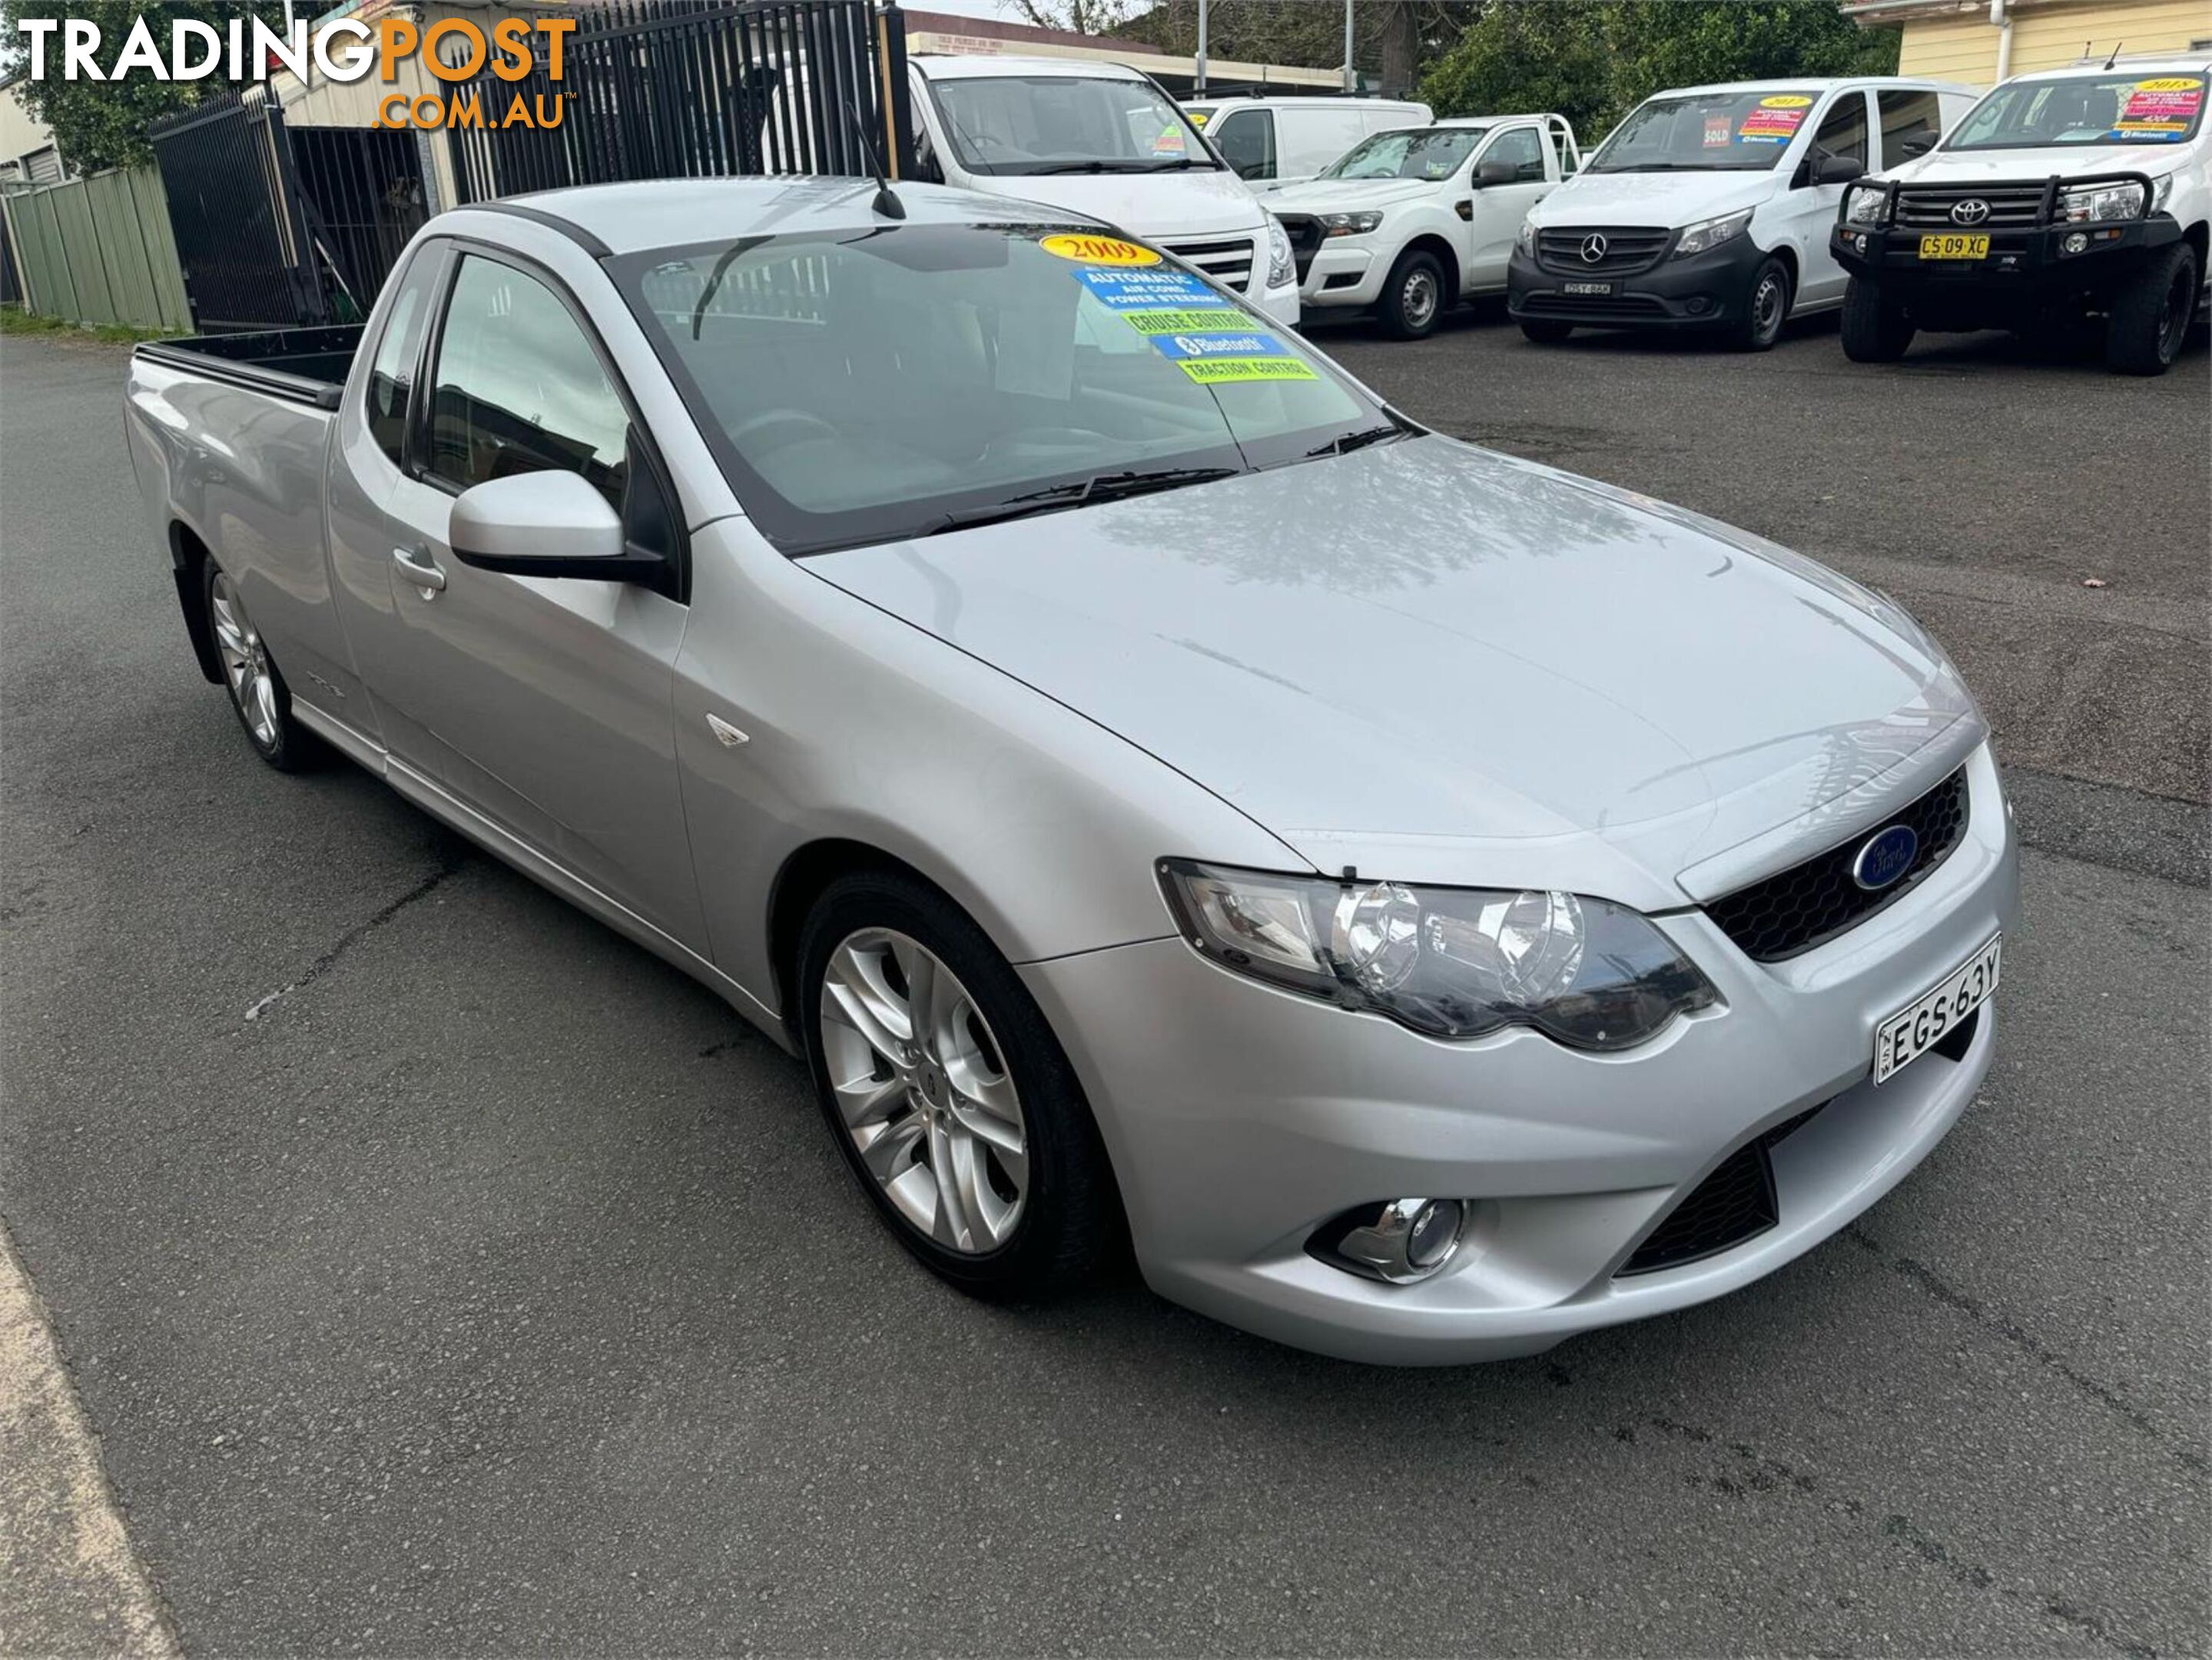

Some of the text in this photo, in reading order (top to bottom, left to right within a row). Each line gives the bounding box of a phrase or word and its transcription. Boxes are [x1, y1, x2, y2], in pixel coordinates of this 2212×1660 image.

[2147, 81, 2192, 89] 2018
[1704, 129, 1729, 143] SOLD
[1065, 239, 1137, 259] 2009
[1086, 272, 1192, 285] AUTOMATIC
[1123, 285, 1149, 294] AIR
[1106, 294, 1224, 304] POWER STEERING
[1129, 313, 1258, 331] CRUISE CONTROL
[1196, 336, 1265, 352] Bluetooth
[1186, 361, 1312, 377] TRACTION CONTROL
